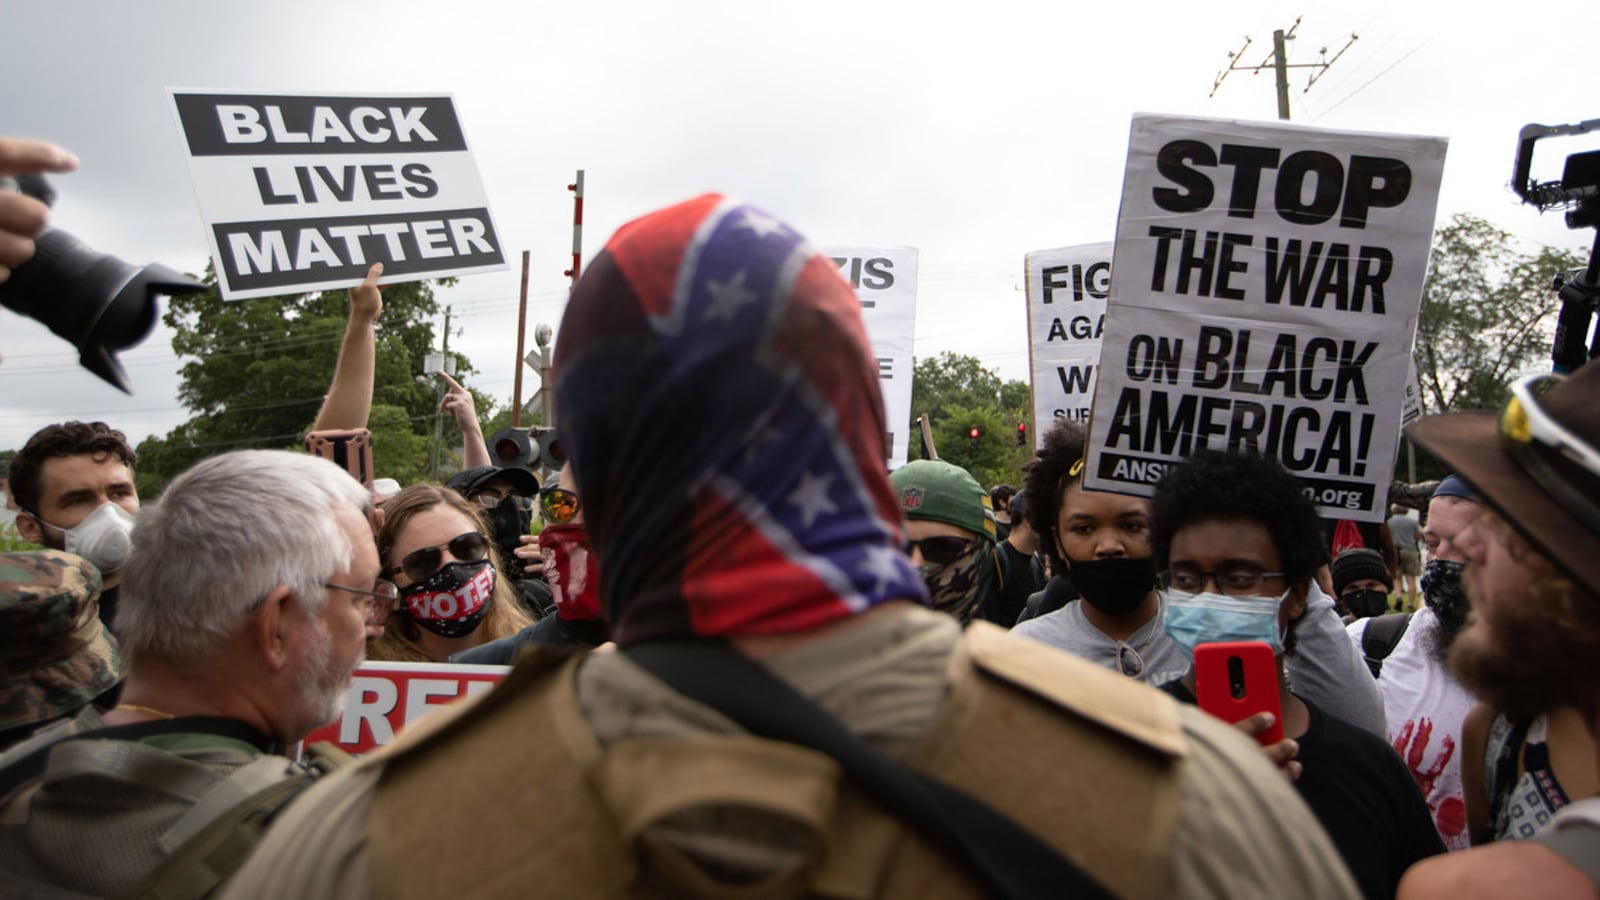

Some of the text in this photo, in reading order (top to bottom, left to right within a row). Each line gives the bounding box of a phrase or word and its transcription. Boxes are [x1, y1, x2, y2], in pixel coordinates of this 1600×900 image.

[215, 104, 438, 144] BLACK
[252, 163, 439, 205] LIVES
[1152, 139, 1412, 229] STOP
[227, 217, 495, 276] MATTER
[1148, 225, 1394, 315] THE WAR
[1057, 364, 1100, 394] W
[1126, 325, 1380, 406] ON BLACK
[1104, 386, 1376, 477] AMERICA!
[1111, 458, 1168, 483] ANS
